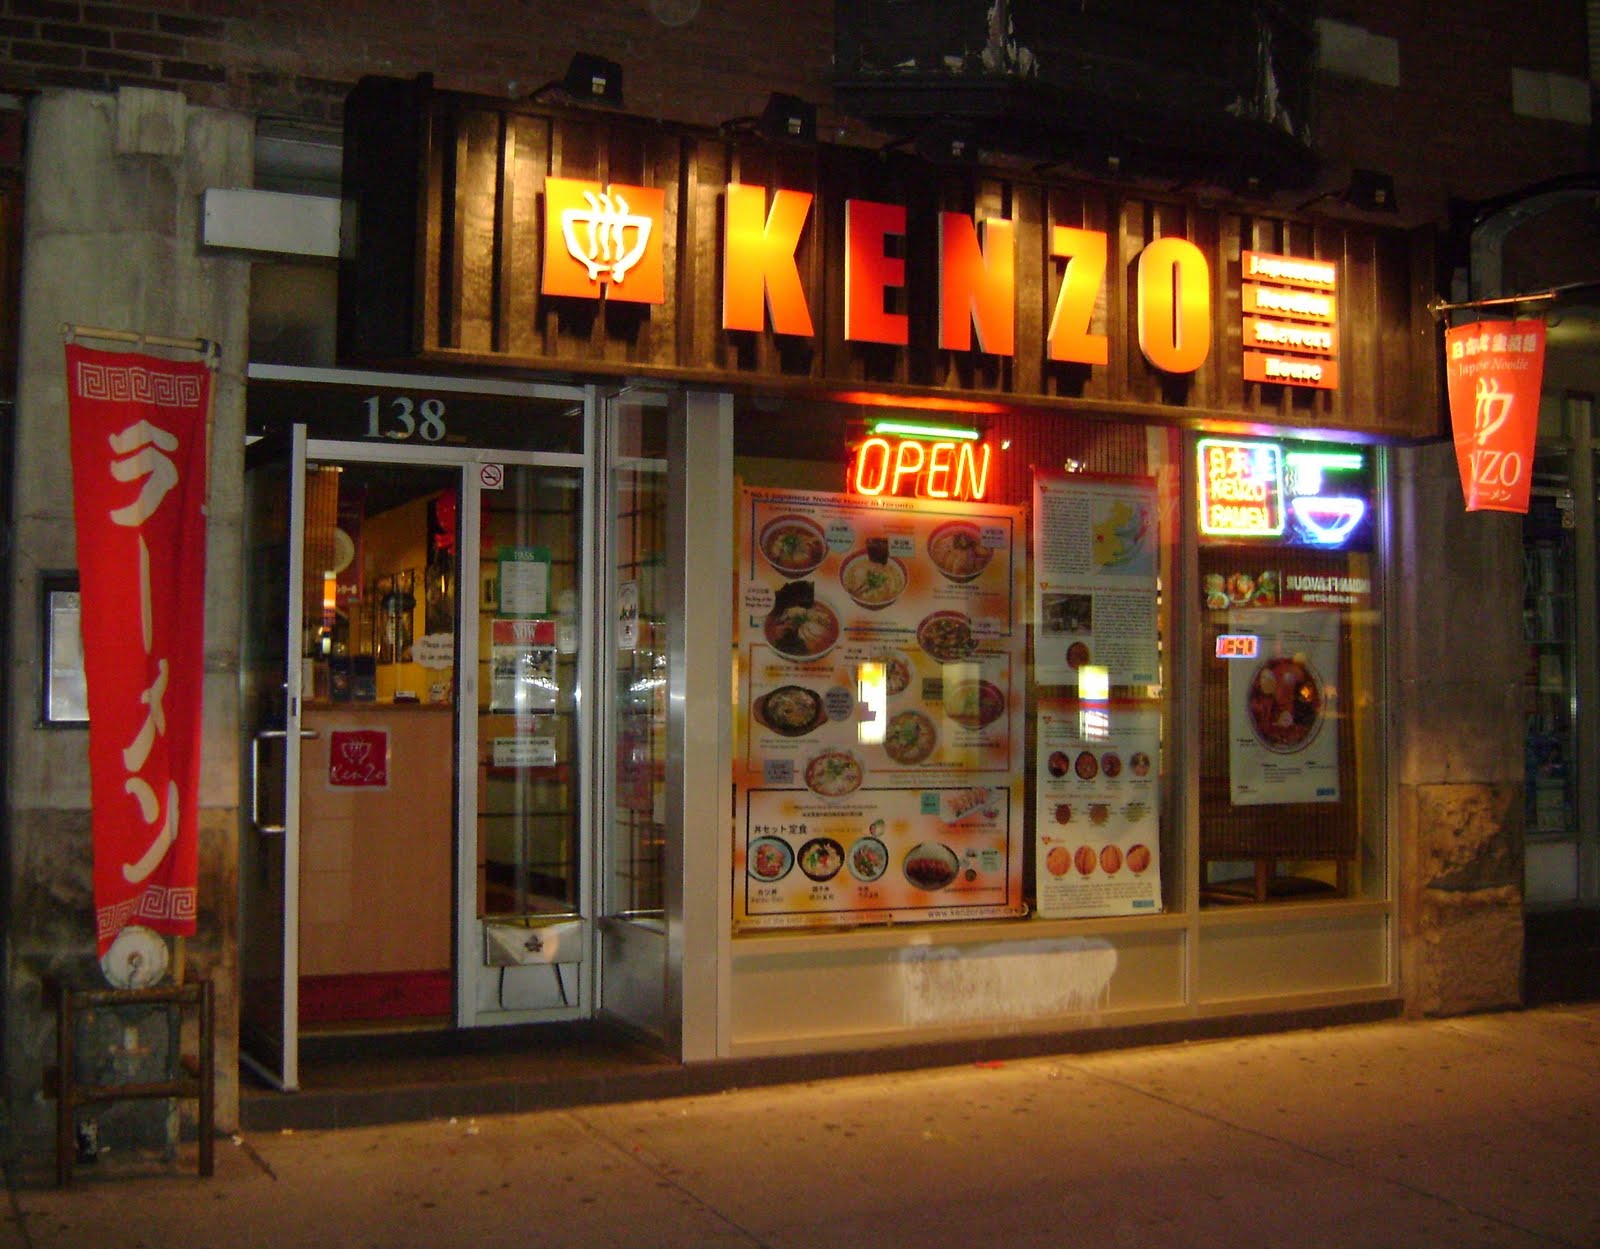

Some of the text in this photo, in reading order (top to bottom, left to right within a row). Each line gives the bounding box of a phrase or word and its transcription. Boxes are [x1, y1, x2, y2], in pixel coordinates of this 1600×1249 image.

[722, 183, 1211, 374] KENZO
[1265, 357, 1322, 384] House
[1491, 357, 1529, 371] Noodle
[362, 396, 447, 442] 138
[855, 437, 991, 500] OPEN
[1469, 450, 1521, 487] NZO
[514, 551, 535, 560] PASS
[512, 623, 537, 640] NOW
[108, 418, 181, 884] ラーメン
